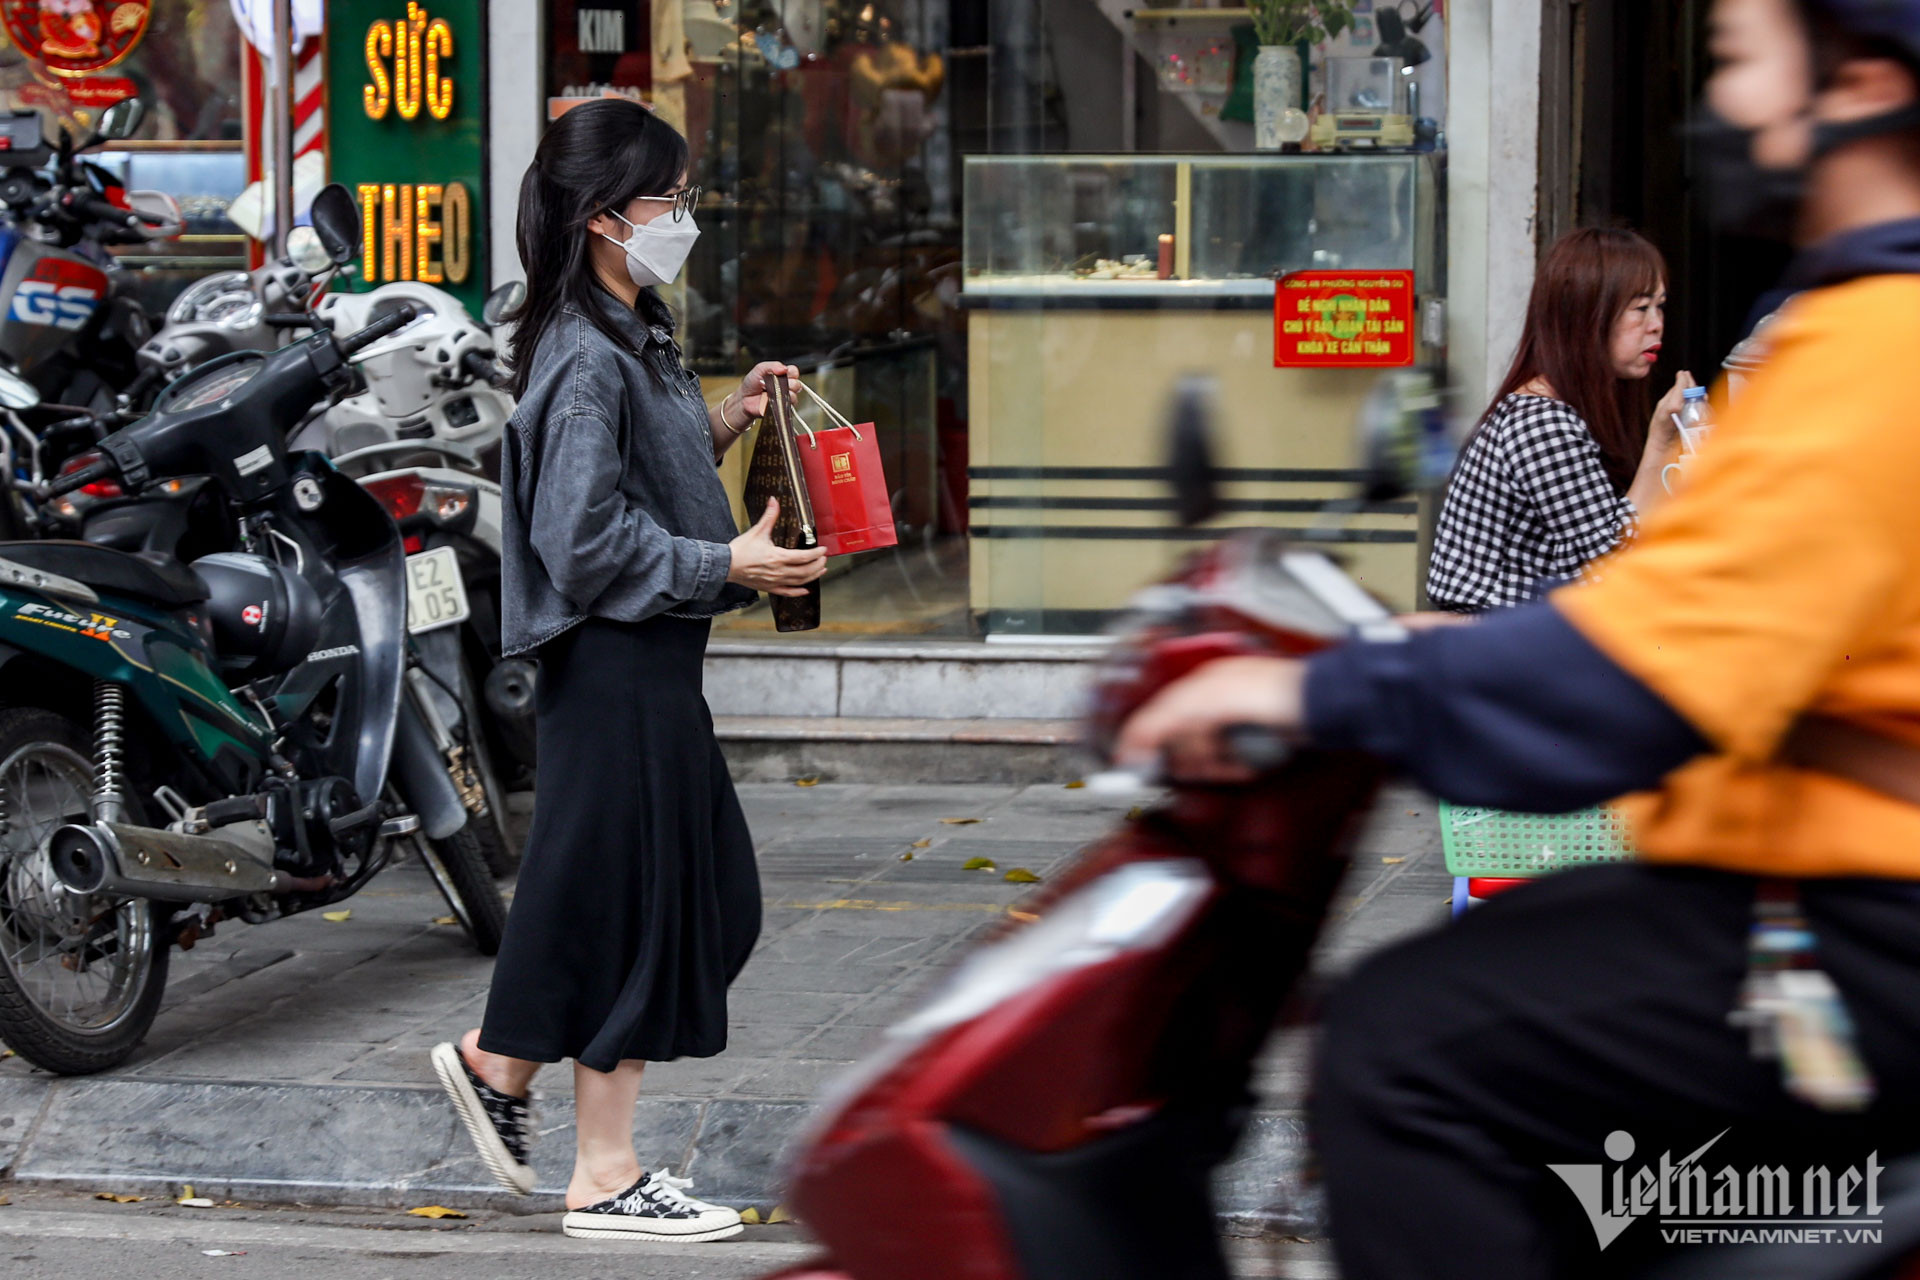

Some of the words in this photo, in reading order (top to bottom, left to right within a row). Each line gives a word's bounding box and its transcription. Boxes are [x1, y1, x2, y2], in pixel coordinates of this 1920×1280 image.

[578, 8, 624, 52] KIM
[363, 1, 453, 119] SỨC
[357, 181, 470, 283] THEO
[1309, 280, 1320, 288] AN
[12, 281, 96, 331] GS
[1339, 298, 1367, 312] NHÂN
[1369, 297, 1390, 312] DÂN
[1283, 317, 1303, 333] CHÚ
[1366, 318, 1381, 333] TÀI
[1383, 316, 1404, 333] SẢN
[1326, 341, 1338, 354] XE
[1364, 338, 1390, 356] THẬN
[307, 644, 360, 661] HONDA
